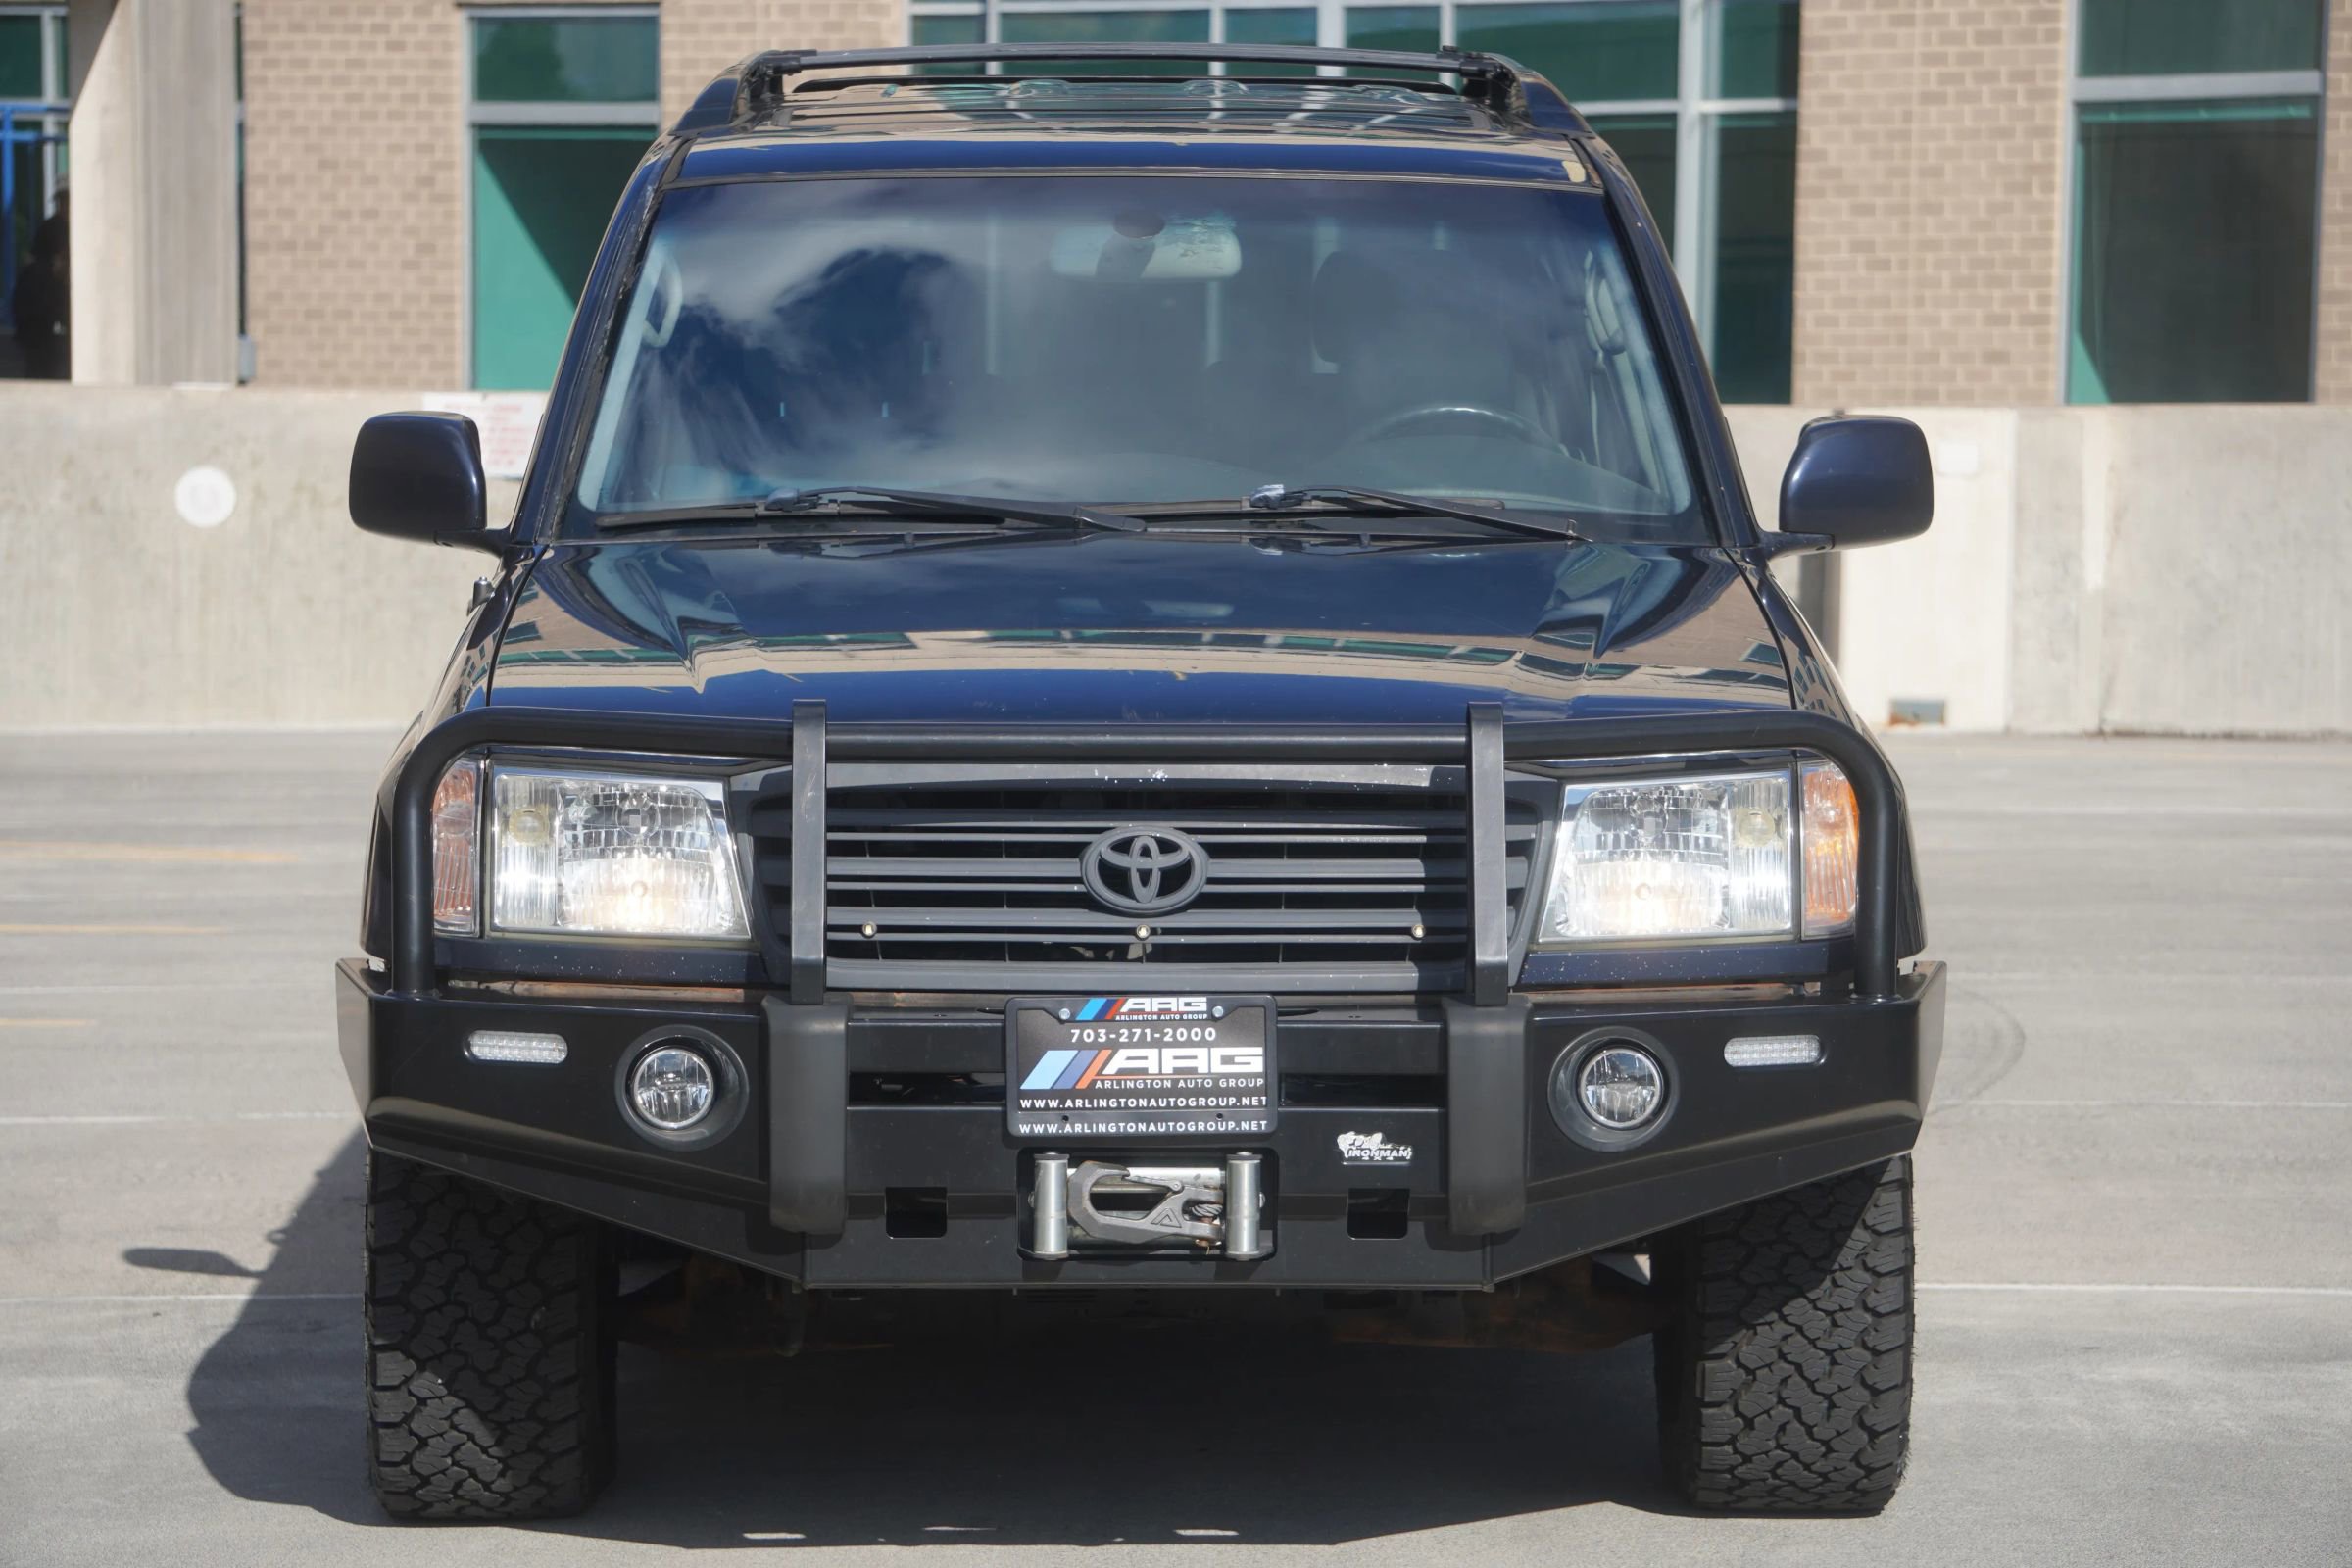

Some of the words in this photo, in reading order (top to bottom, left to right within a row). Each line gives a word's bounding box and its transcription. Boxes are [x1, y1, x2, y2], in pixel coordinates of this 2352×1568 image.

[1120, 997, 1207, 1012] AAG
[1070, 1027, 1217, 1043] 703-271-2000
[1102, 1047, 1263, 1074] AAG
[1095, 1080, 1172, 1089] ARLINGTON
[1178, 1079, 1213, 1088] AUTO
[1219, 1078, 1264, 1087] GROUP
[1020, 1096, 1267, 1108] WWW.ARLINGTONAUTOGROUP.NET
[1019, 1120, 1267, 1134] WWW.ARLINGTONAUTOGROUP.NET
